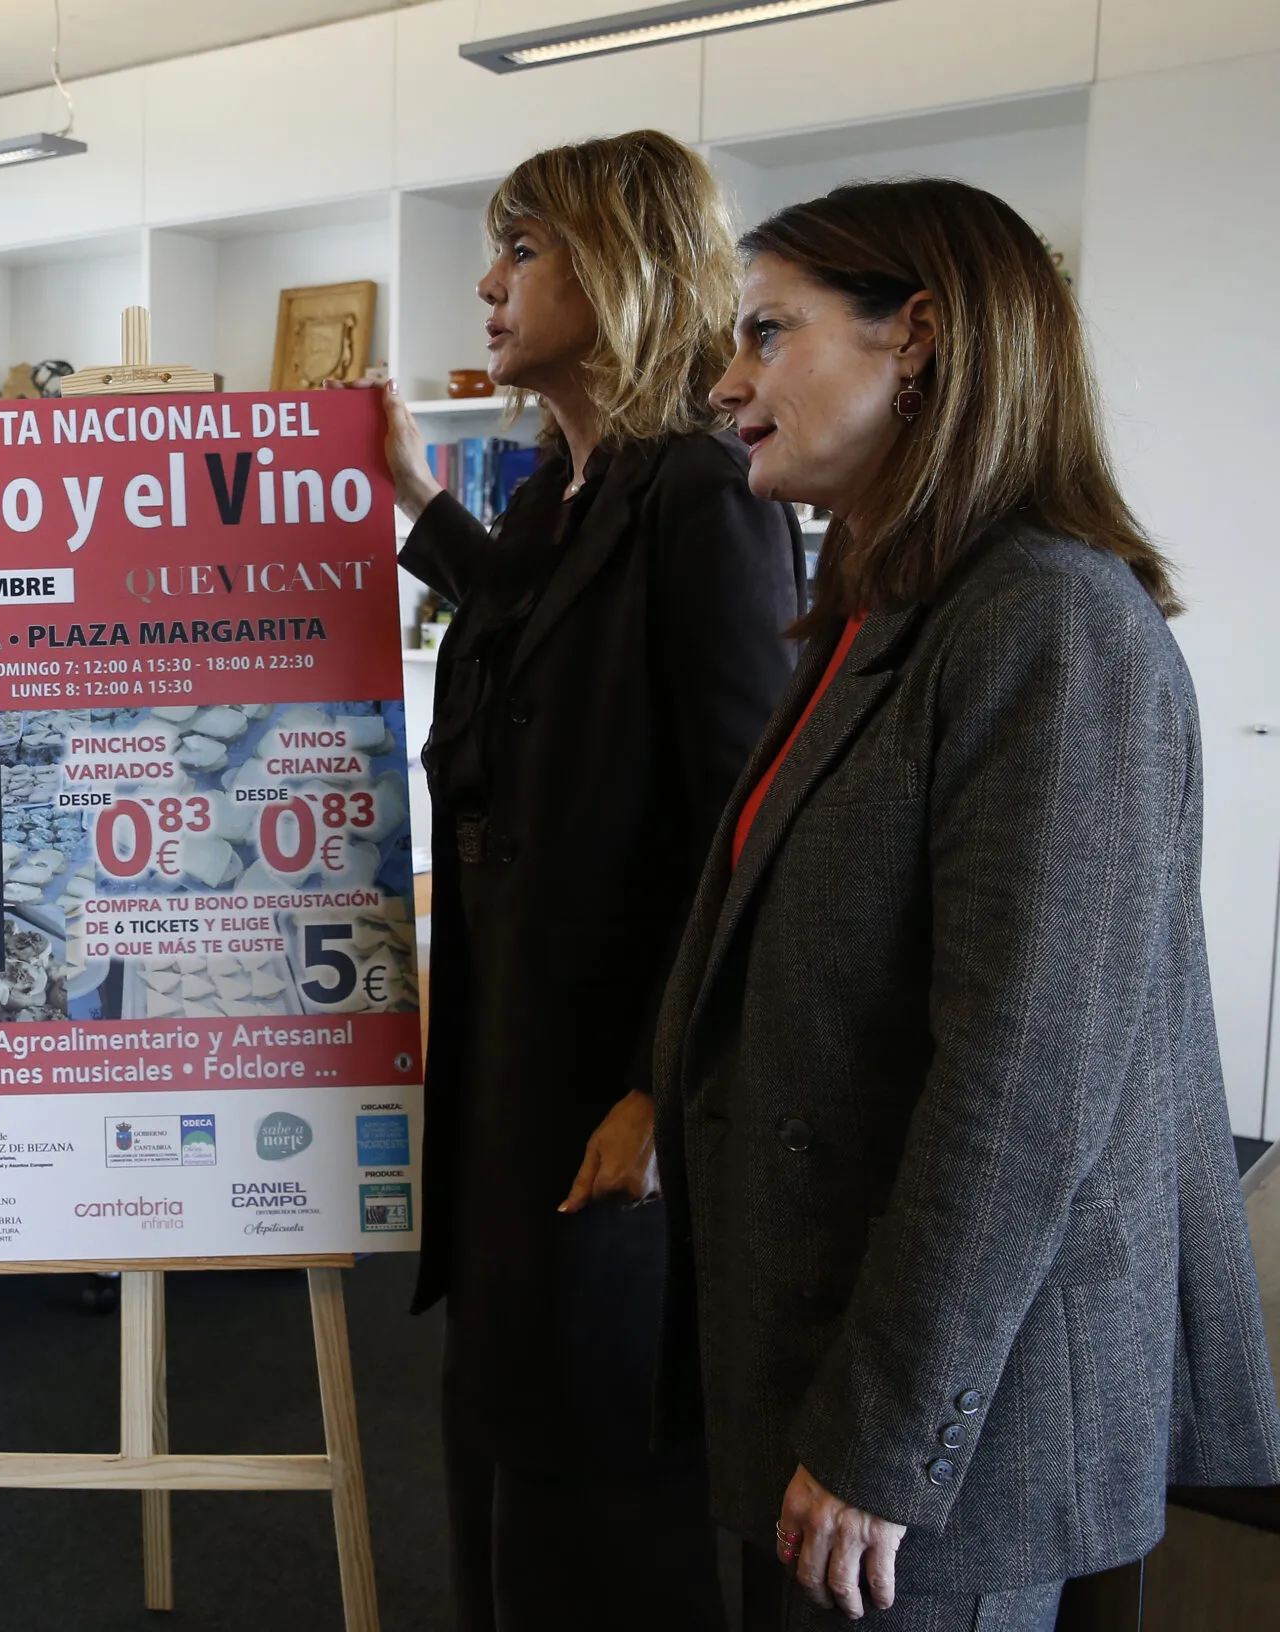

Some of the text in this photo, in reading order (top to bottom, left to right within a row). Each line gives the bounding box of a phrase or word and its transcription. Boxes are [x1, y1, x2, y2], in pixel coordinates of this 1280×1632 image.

[53, 405, 240, 444] NACIONAL
[252, 401, 319, 438] DEL
[63, 476, 103, 552] y
[124, 452, 185, 529] el
[204, 447, 372, 526] Vino
[126, 561, 370, 604] QUEVICANT
[28, 622, 130, 648] PLAZA
[139, 617, 326, 644] MARGARITA
[64, 660, 79, 675] 7:
[84, 658, 128, 674] 12:00
[132, 658, 143, 673] A
[147, 657, 194, 672] 15:30
[206, 655, 251, 671] 18:00
[255, 655, 265, 670] A
[268, 654, 314, 669] 22:30
[11, 679, 193, 698] LUNES 8: 12:00 A 15:30
[71, 735, 166, 755] PINCHOS
[279, 731, 346, 749] VINOS
[65, 761, 174, 781] VARIADOS
[266, 757, 362, 775] CRIANZA
[59, 793, 112, 807] DESDE
[235, 788, 288, 802] DESDE
[85, 891, 379, 914] COMPRA TU BONO DEGUSTACIÓN
[86, 917, 269, 935] DE 6 TICKETS Y ELIGE
[86, 937, 285, 956] LO QUE MÁS TE GUSTE
[301, 924, 358, 1004] 5
[209, 1032, 223, 1055] y
[231, 1020, 353, 1049] Artesanal
[52, 1056, 173, 1084] musicales
[204, 1054, 305, 1080] Folclore
[182, 1119, 213, 1127] ODECA
[262, 1120, 304, 1135] sabe a
[9, 1143, 25, 1153] DE
[27, 1142, 74, 1153] BEZANA
[263, 1134, 304, 1151] norte
[231, 1182, 307, 1195] DANIEL
[74, 1196, 183, 1218] cantabria
[231, 1195, 308, 1208] CAMPO
[141, 1216, 184, 1230] infinita
